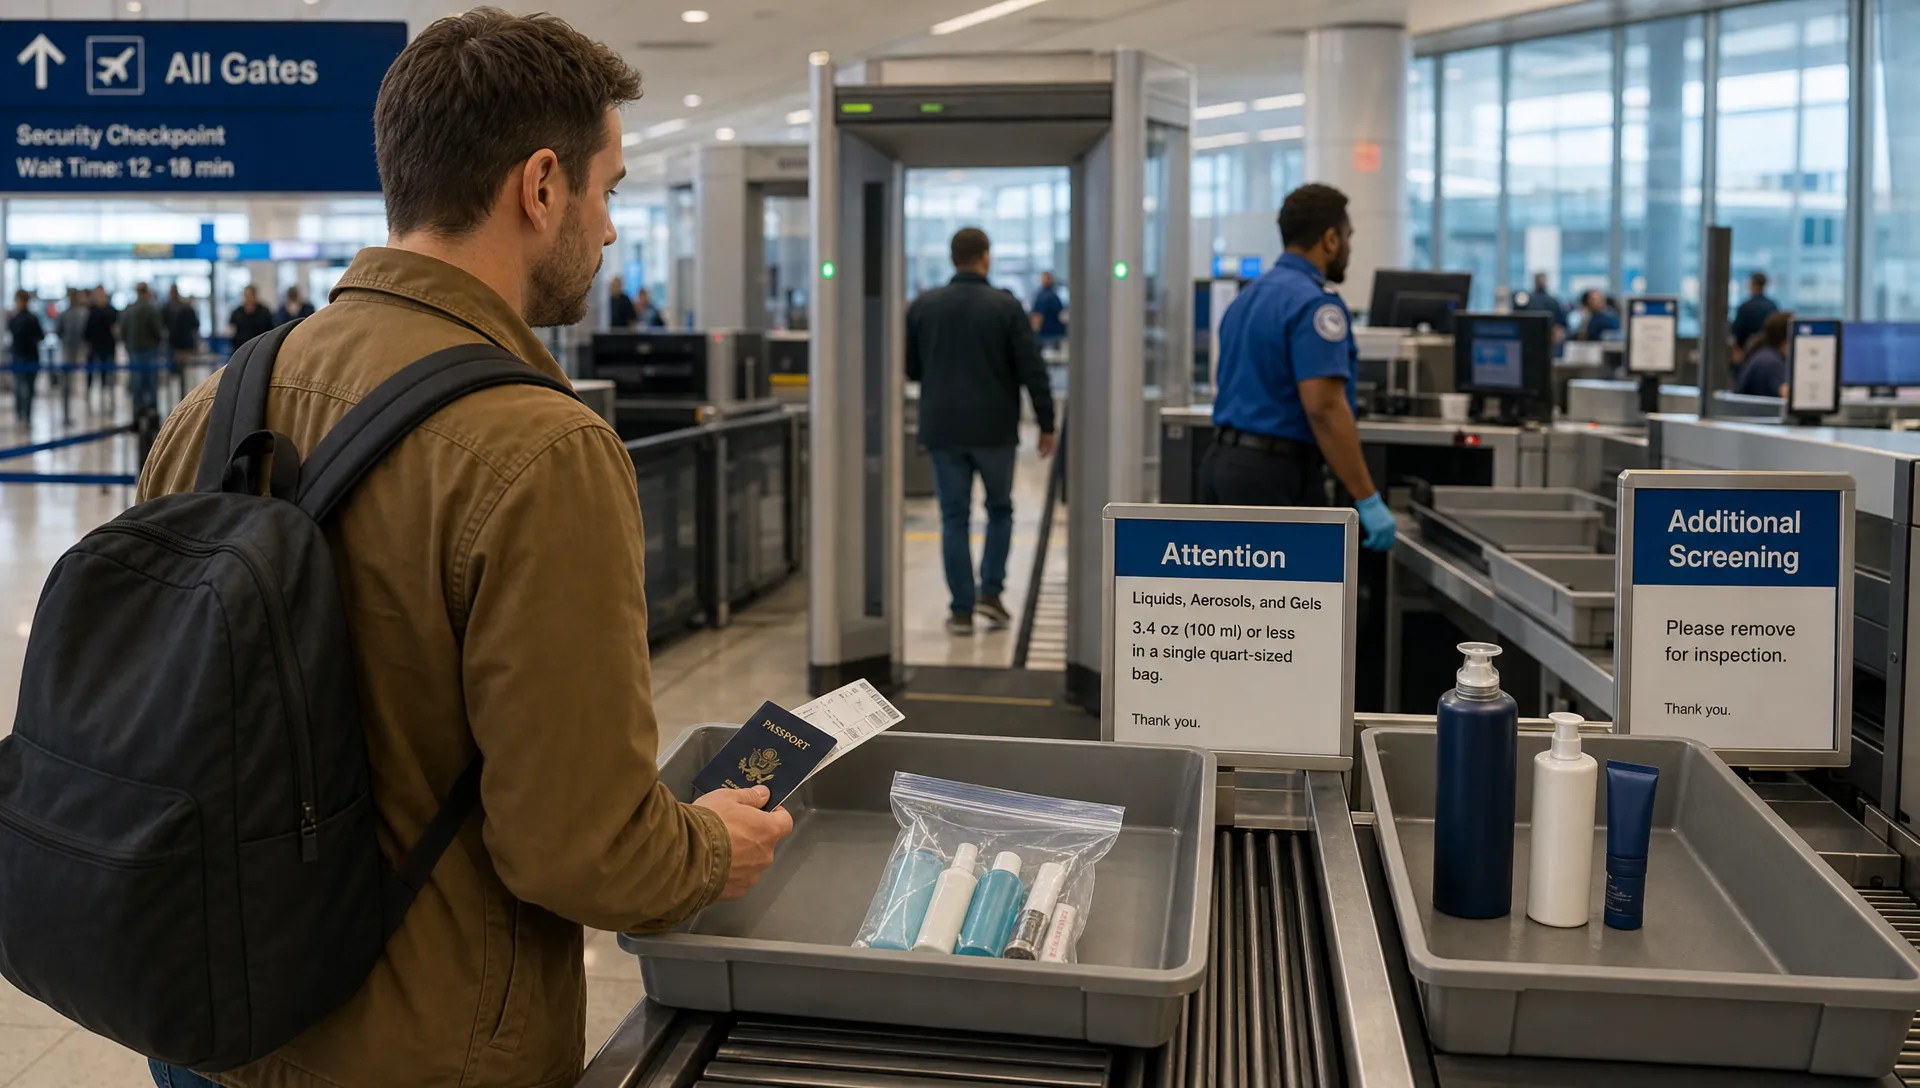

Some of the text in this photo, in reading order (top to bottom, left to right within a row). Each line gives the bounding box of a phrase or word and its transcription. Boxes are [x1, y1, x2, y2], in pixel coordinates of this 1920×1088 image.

[165, 52, 318, 85] All Gates
[16, 124, 226, 149] Security Checkpoint
[16, 157, 63, 177] Wait
[67, 157, 123, 177] Time:
[128, 157, 151, 177] 12
[196, 157, 234, 177] min
[1667, 509, 1801, 534] Additional
[1161, 542, 1286, 569] Attention
[1669, 544, 1799, 575] Screening
[1132, 591, 1322, 610] Liquids, Aerosols, and Gels
[1132, 621, 1295, 640] 3.4 oz (100 ml) or less
[1666, 620, 1796, 637] Please remove
[1132, 644, 1293, 664] in a single quart-sized
[1665, 646, 1787, 666] for inspection.
[1132, 667, 1163, 684] bag.
[1664, 703, 1731, 718] Thank you.
[1131, 714, 1201, 730] Thank you.
[762, 719, 811, 751] PASSPORT
